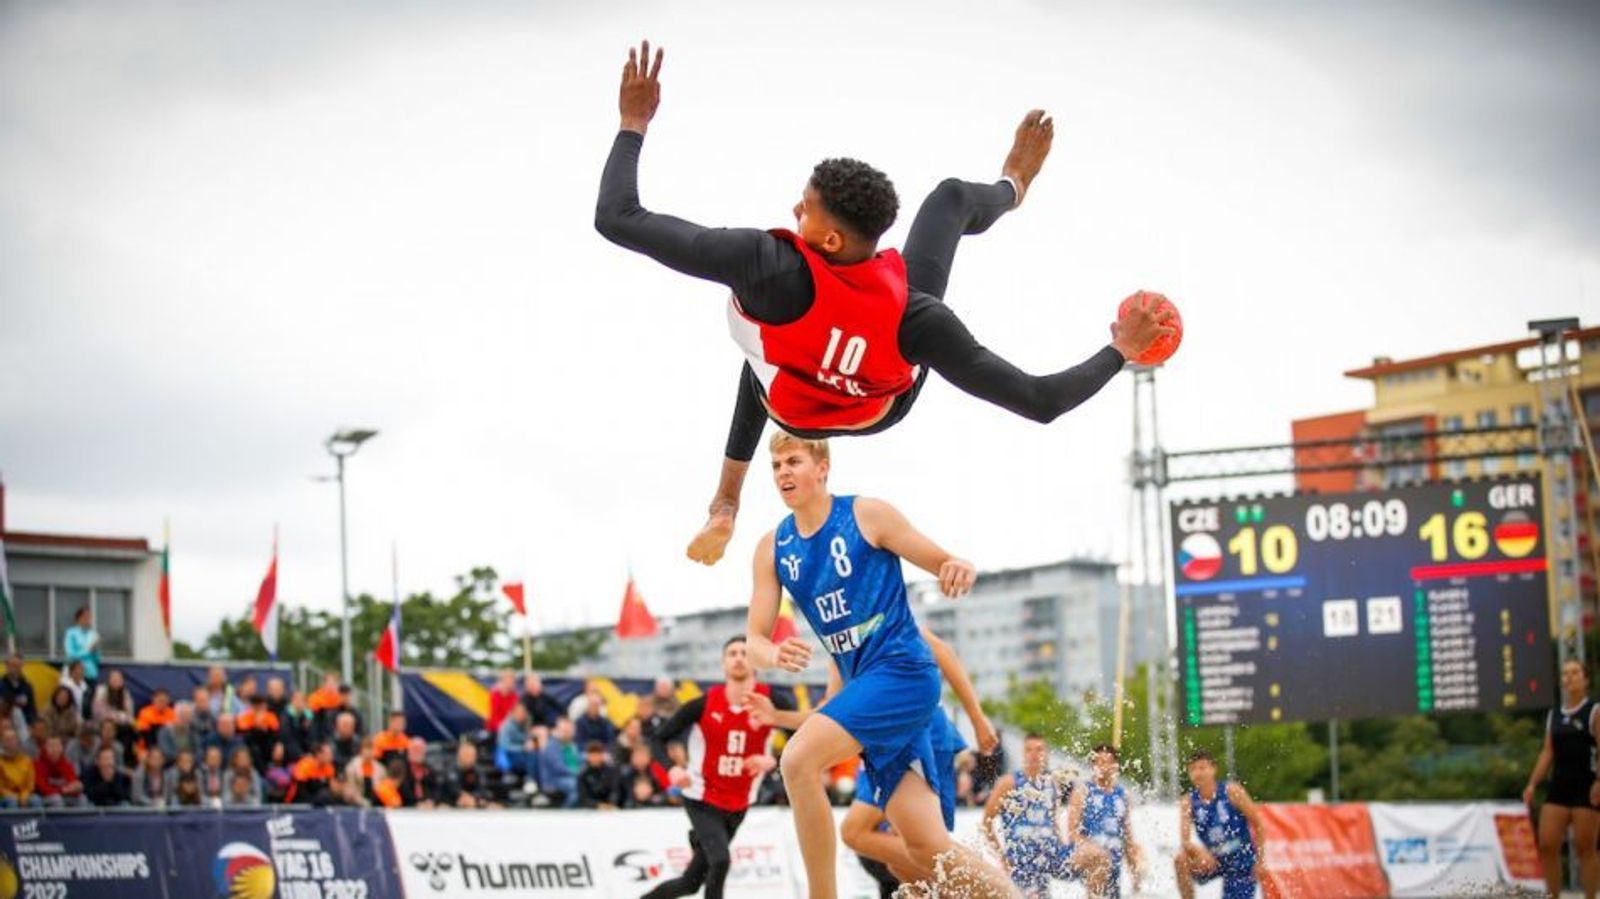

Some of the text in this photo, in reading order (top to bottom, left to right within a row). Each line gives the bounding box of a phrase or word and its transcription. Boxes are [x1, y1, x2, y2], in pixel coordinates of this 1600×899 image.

[821, 327, 867, 375] 10
[1487, 483, 1536, 509] GER
[1178, 507, 1220, 533] CZE
[1306, 498, 1408, 541] 08:09
[1418, 511, 1490, 562] 16
[830, 535, 853, 578] 8
[1228, 524, 1299, 575] 10
[815, 588, 852, 624] CZE
[18, 853, 150, 880] CHAMPIONSHIPS
[308, 851, 335, 879] 16
[459, 854, 594, 889] hummel
[23, 881, 68, 899] 2022
